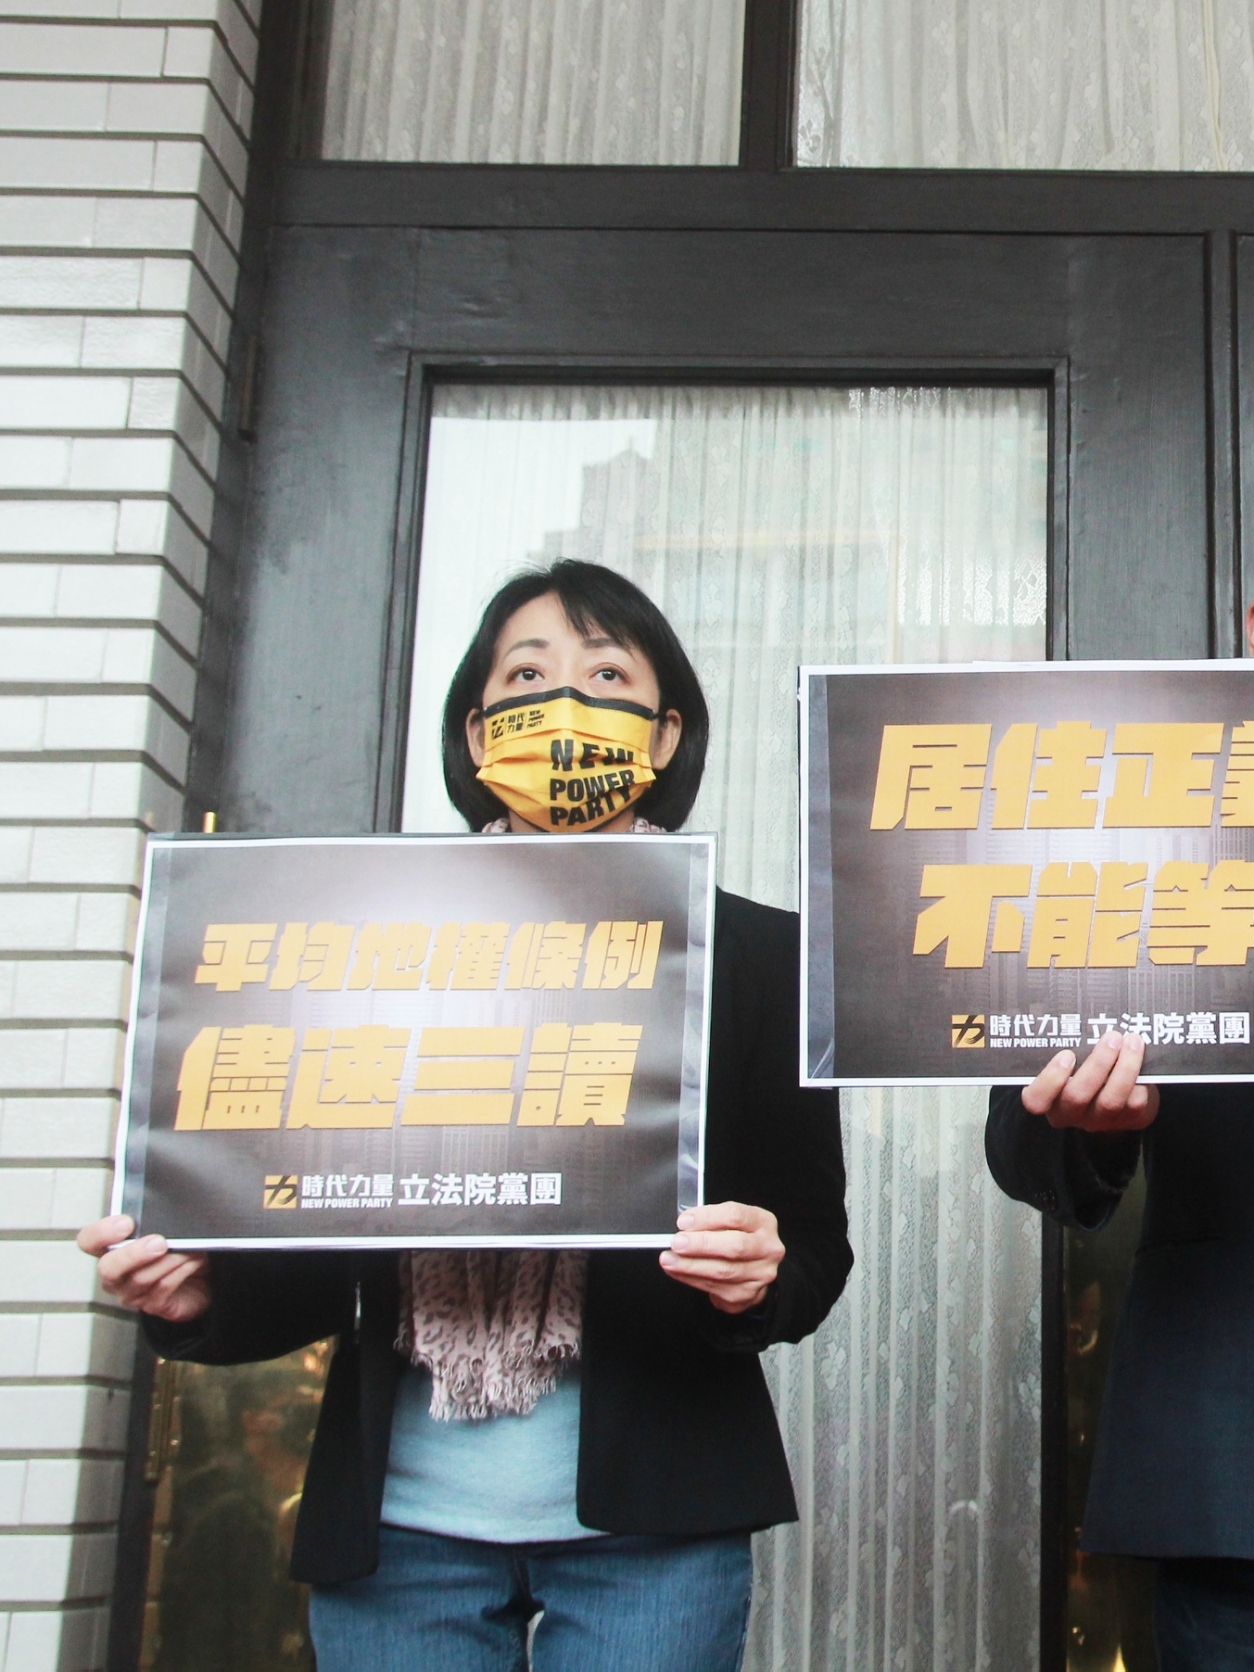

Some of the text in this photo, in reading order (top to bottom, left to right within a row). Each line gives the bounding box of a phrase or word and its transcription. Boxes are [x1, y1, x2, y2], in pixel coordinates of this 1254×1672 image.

[550, 739, 634, 772] NEW
[549, 769, 635, 801] POWER
[550, 785, 633, 826] PARTY
[195, 920, 664, 992] 平均地權條例
[989, 1011, 1251, 1046] 時代力量 立法院黨團
[989, 1037, 1082, 1048] NEW POWER PARTY
[173, 1022, 644, 1132] 儘速三讀
[301, 1171, 563, 1207] 時代力量 立法院黨團
[301, 1197, 394, 1209] NEW POWER PARTY
